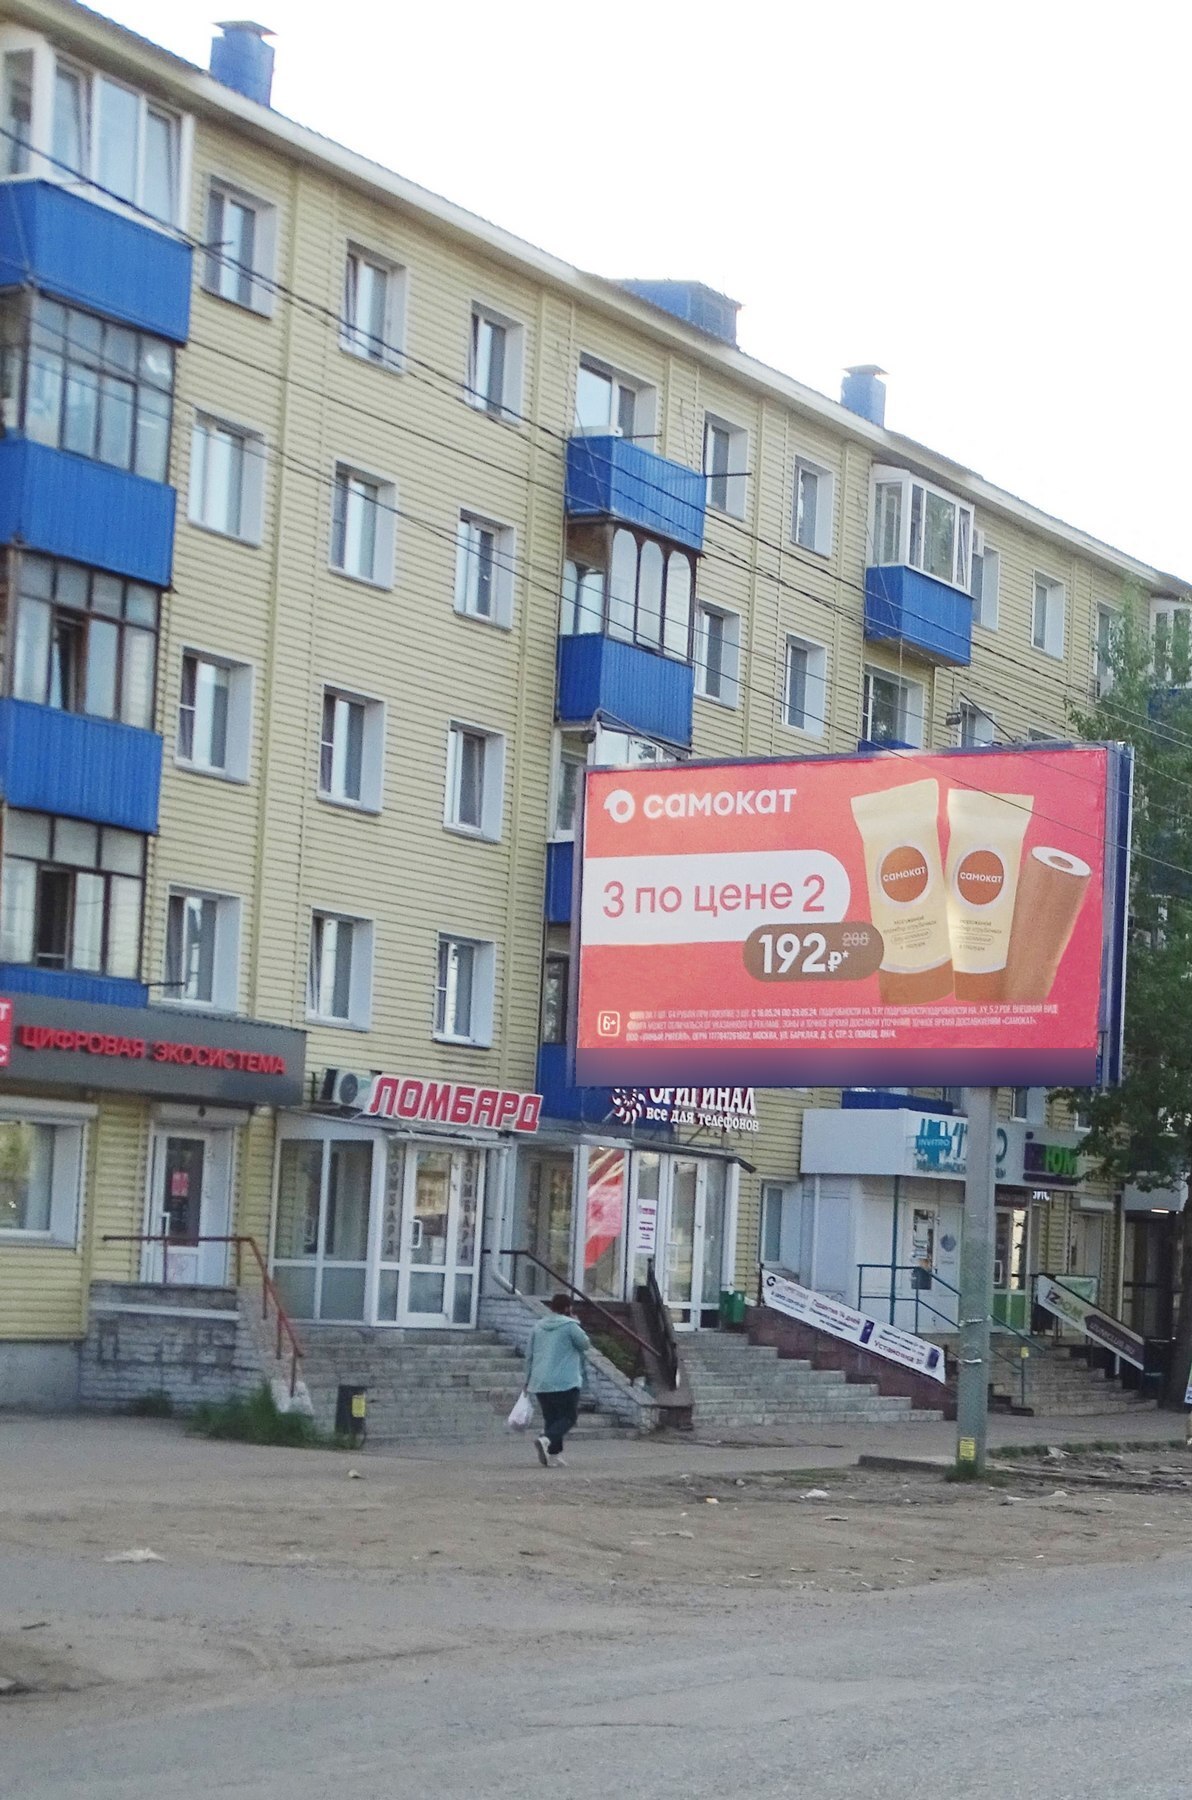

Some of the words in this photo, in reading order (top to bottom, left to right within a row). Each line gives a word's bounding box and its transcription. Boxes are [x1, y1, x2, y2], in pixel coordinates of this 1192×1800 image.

[643, 788, 797, 818] самокат
[883, 866, 926, 882] самокат
[960, 872, 1003, 883] самокат
[602, 880, 625, 918] 3
[635, 886, 682, 913] по
[693, 883, 793, 917] цене
[802, 874, 825, 913] 2
[602, 1016, 617, 1031] 6+
[18, 1026, 147, 1058] ЦИФРОВАЯ
[153, 1041, 286, 1075] ЭКОСИСТЕМА
[646, 1107, 668, 1121] все
[670, 1109, 694, 1124] для
[697, 1113, 760, 1133] телефонов
